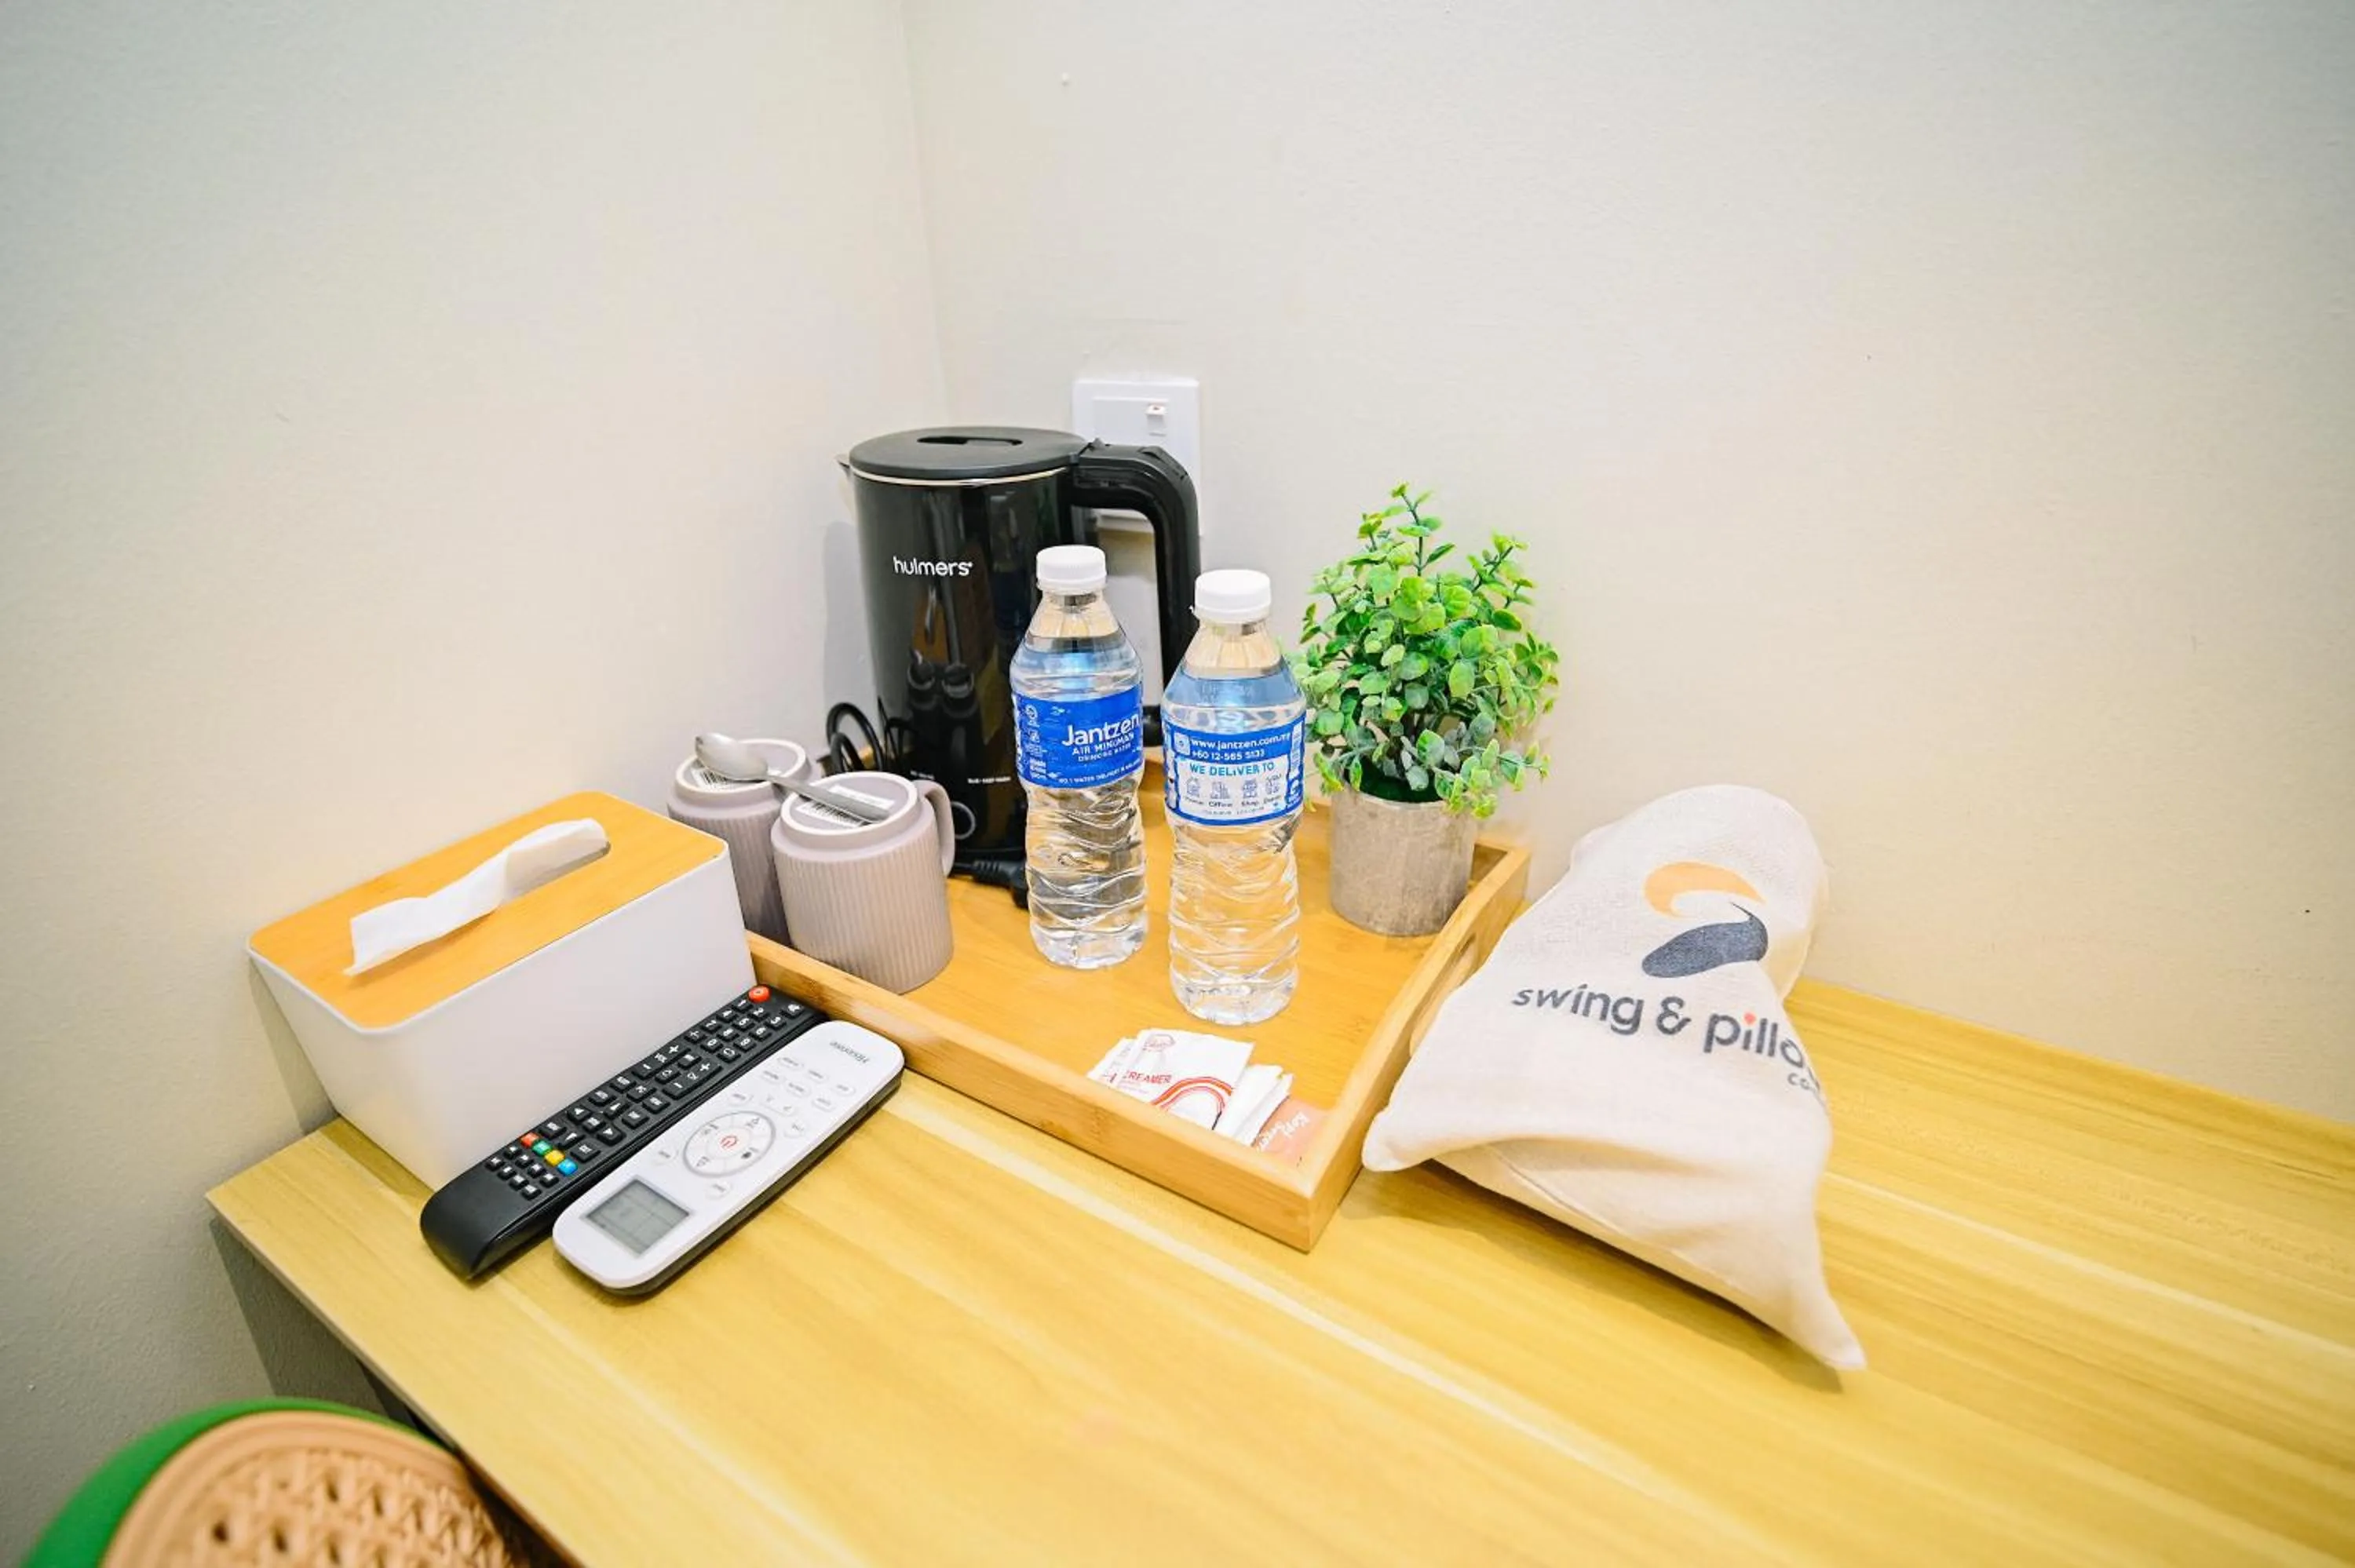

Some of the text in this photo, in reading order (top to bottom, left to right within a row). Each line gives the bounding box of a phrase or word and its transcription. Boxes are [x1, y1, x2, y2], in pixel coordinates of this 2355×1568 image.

[893, 555, 970, 577] hulmers
[1061, 713, 1140, 746] Jantzen
[1072, 745, 1090, 756] AIR
[1189, 761, 1275, 776] WE DELIVER TO
[1512, 983, 1820, 1091] swing & pillo
